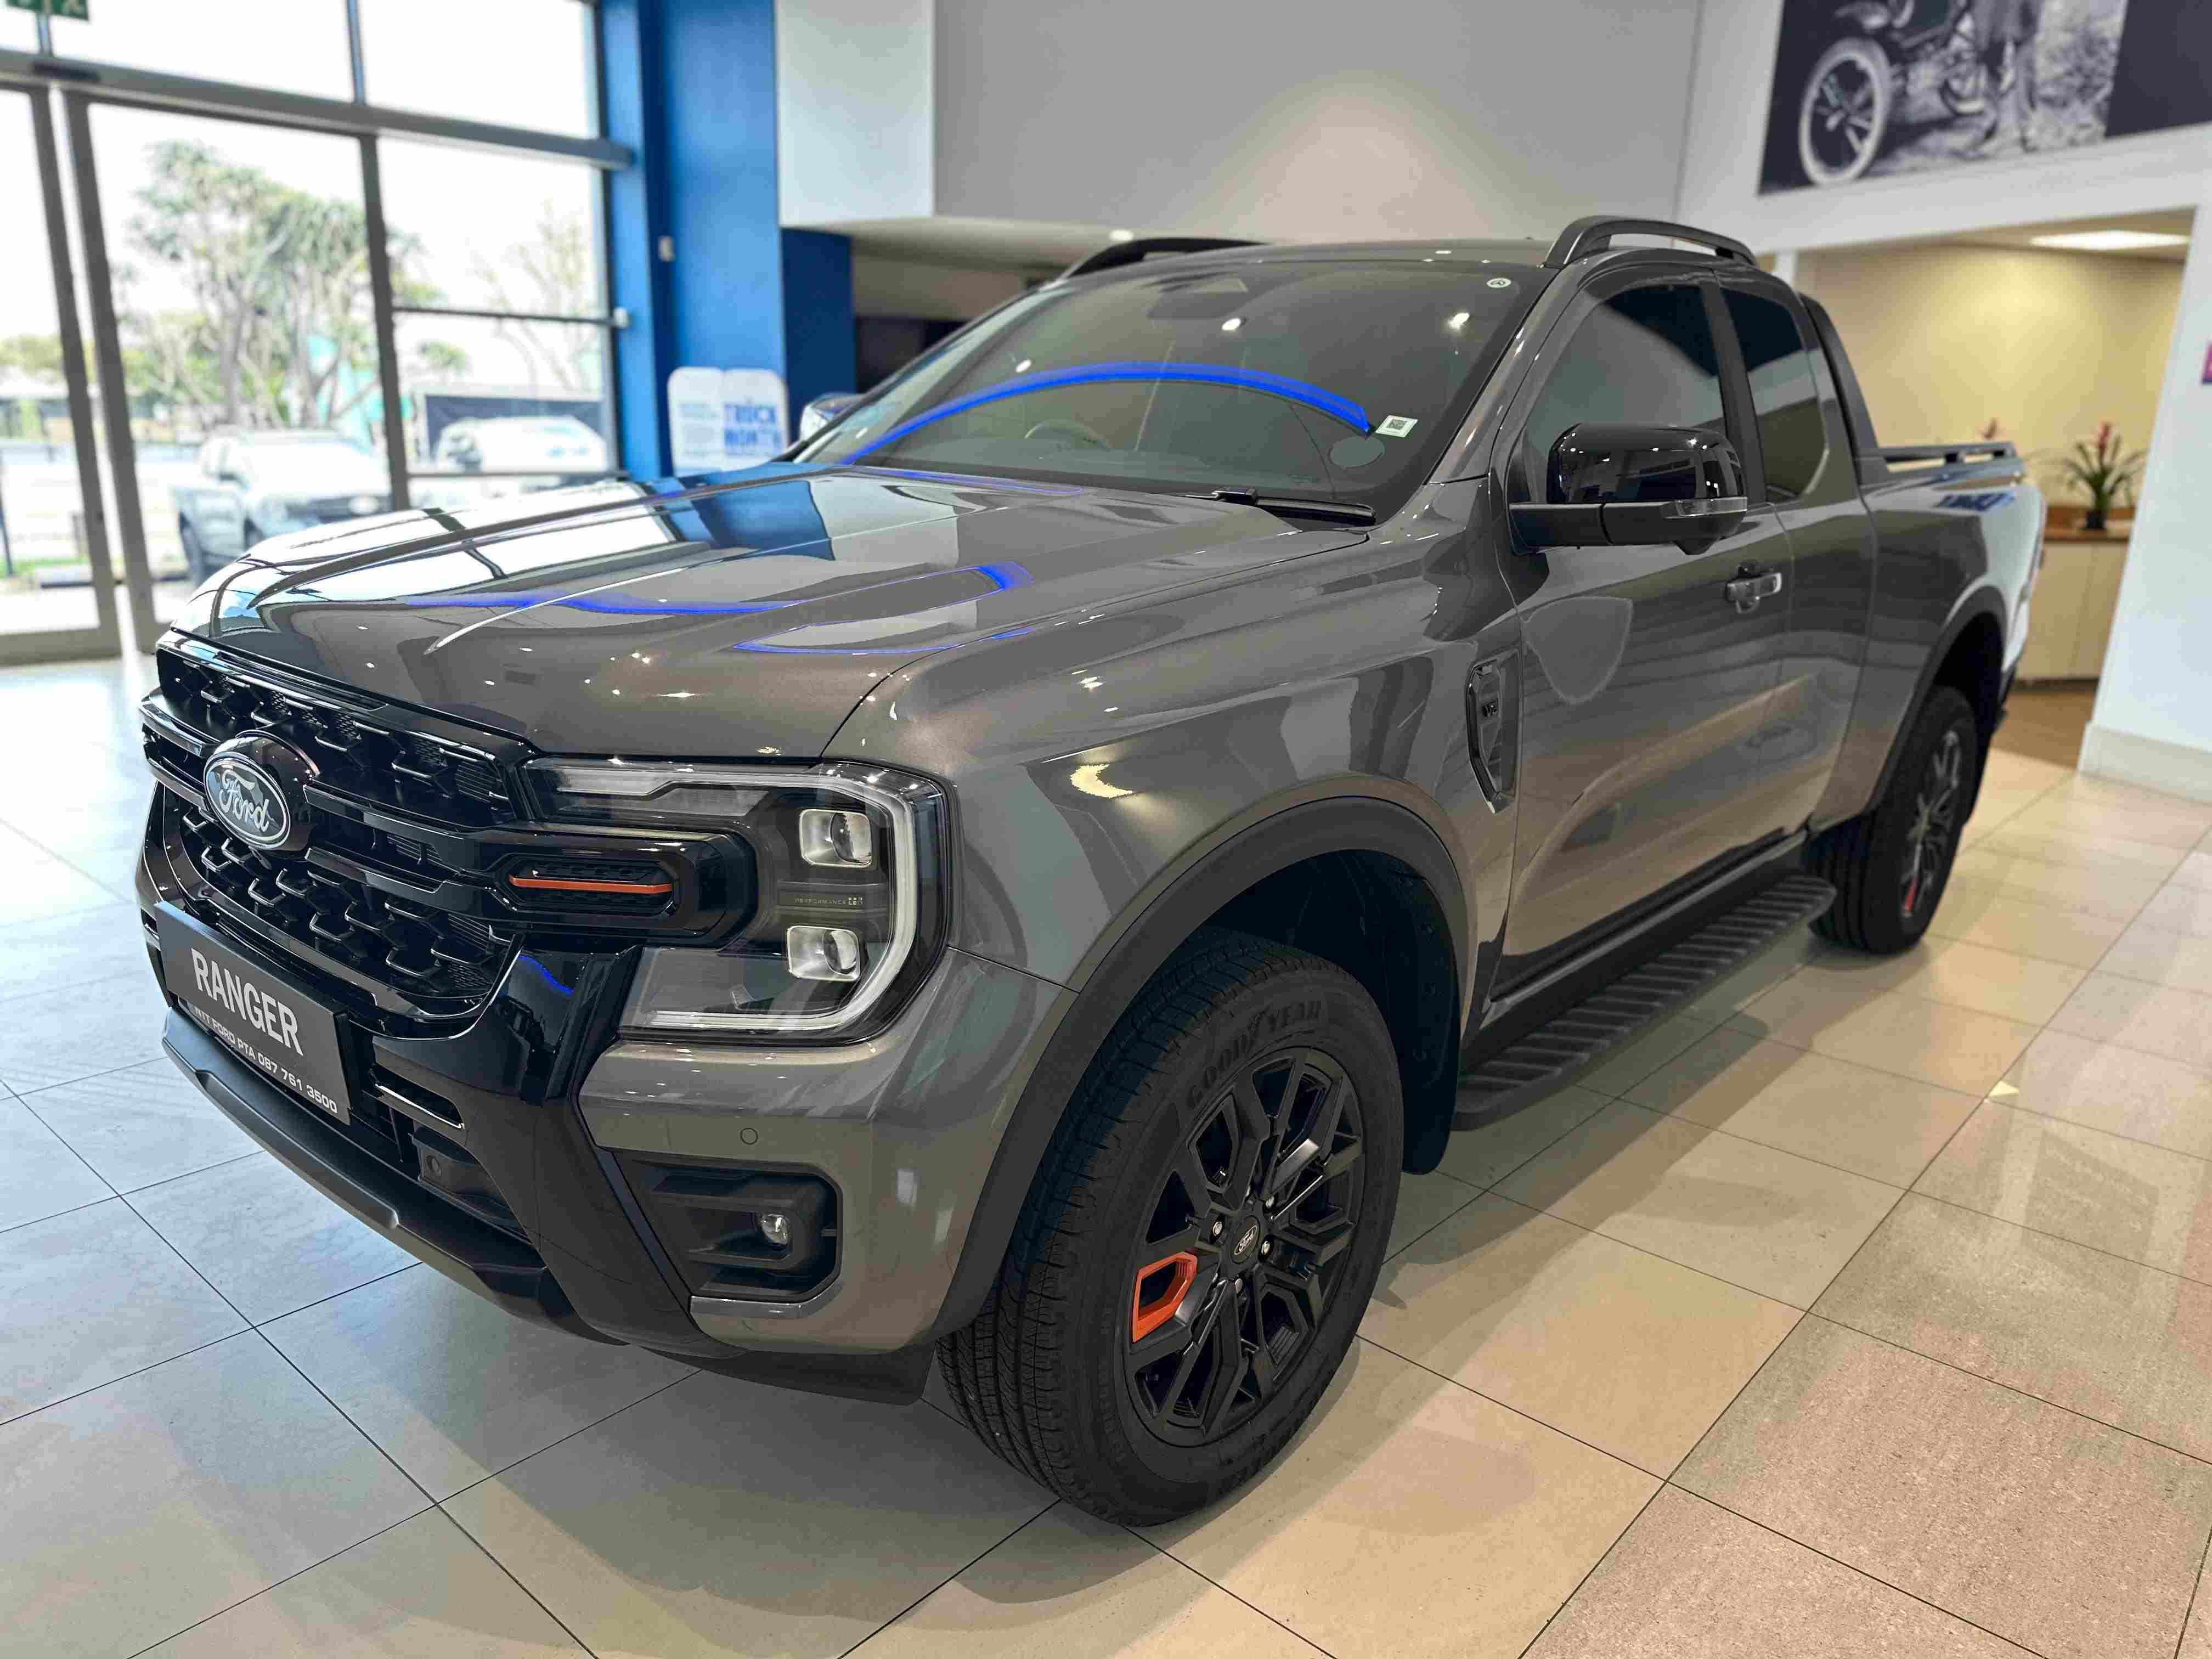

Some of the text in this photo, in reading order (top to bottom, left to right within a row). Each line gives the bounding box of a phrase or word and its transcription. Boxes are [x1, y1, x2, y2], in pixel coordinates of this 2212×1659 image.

[219, 769, 270, 832] Ford
[191, 947, 303, 1056] RANGER
[212, 1018, 236, 1045] FORD
[236, 1037, 256, 1060] PTA
[257, 1052, 278, 1073] 087
[281, 1068, 303, 1091] 761
[307, 1084, 338, 1114] 3500
